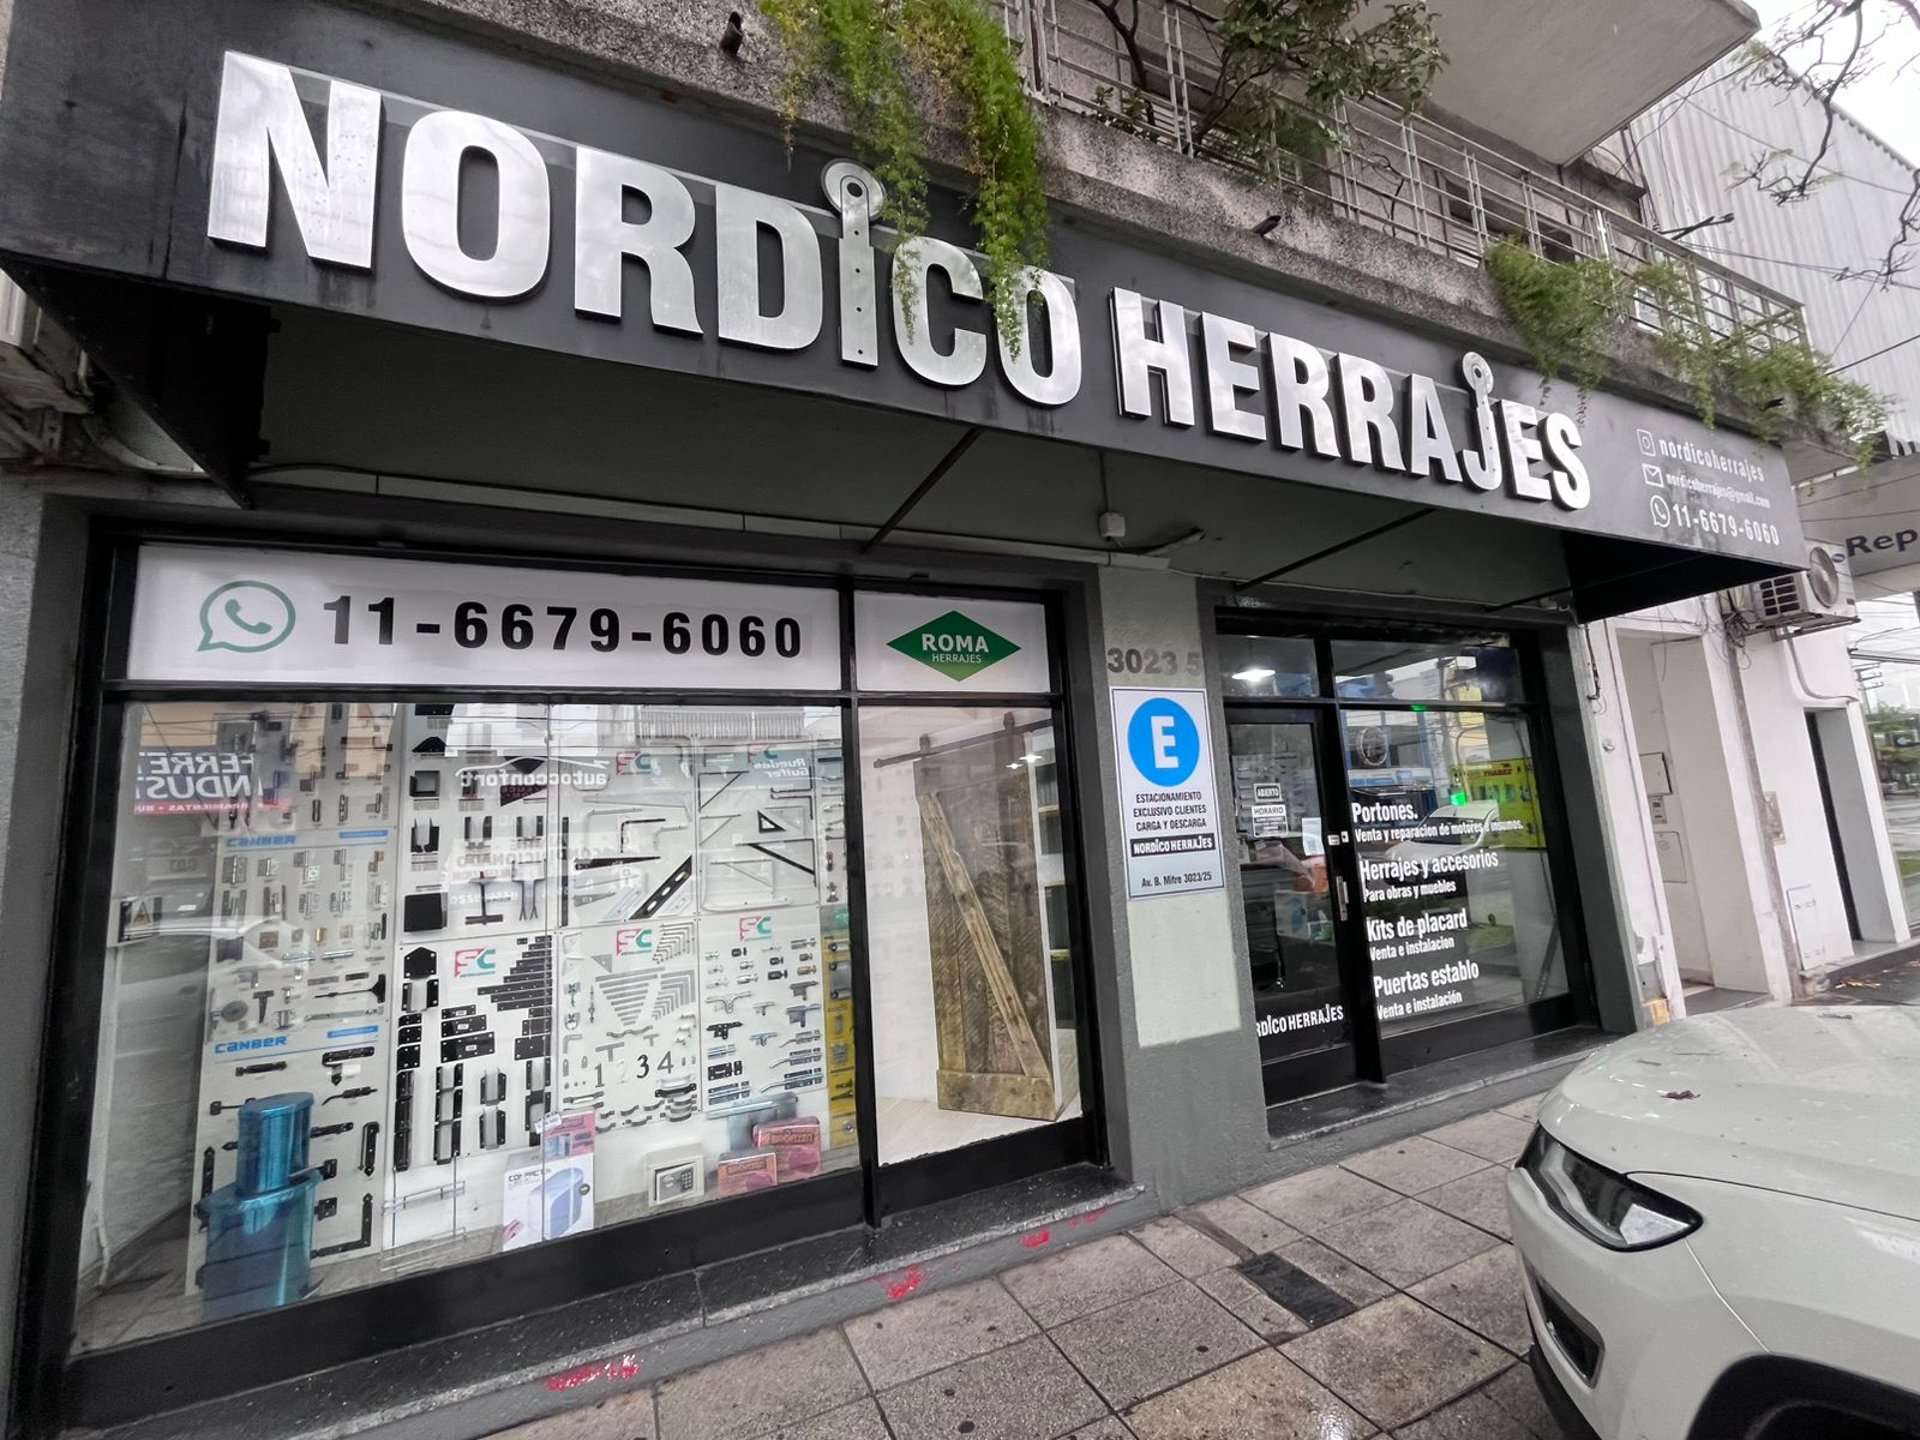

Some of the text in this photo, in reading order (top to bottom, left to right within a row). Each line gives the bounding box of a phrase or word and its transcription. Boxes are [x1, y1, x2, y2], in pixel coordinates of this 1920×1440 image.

[207, 51, 1591, 511] NORDICO HERRAJES
[1659, 439, 1765, 482] nordicoherrajes
[1672, 503, 1780, 545] 11-6679-6060
[323, 595, 802, 659] 11-6679-6060
[921, 633, 989, 653] ROMA
[931, 653, 982, 664] HERRAJES
[1107, 647, 1178, 676] 3023
[1150, 715, 1180, 769] E
[1136, 791, 1202, 804] ESTACIONAMIENTO
[1257, 787, 1279, 797] ABIERTO
[1133, 804, 1207, 818] EXCLUSIVO CLIENTES
[1254, 806, 1284, 815] HORARIO
[1351, 802, 1418, 823] Portones.
[1136, 818, 1207, 831] CARGA Y DESCARGA
[1355, 828, 1382, 843] Venta
[1384, 831, 1390, 844] y
[1439, 824, 1450, 835] de
[1450, 822, 1483, 834] motores
[1133, 835, 1213, 855] NORDICO HERRAJES
[1359, 849, 1499, 882] Herrajes y accesorios
[1141, 877, 1153, 888] Av.
[1154, 876, 1162, 887] B.
[1163, 875, 1182, 886] Mitre
[1363, 879, 1457, 903] Para obras y muebles
[1366, 907, 1468, 942] Kits de placard
[1369, 945, 1397, 961] Venta
[1398, 946, 1405, 957] e
[1373, 959, 1479, 998] Puertas establo
[1287, 1003, 1344, 1031] HERRAJES
[1377, 1003, 1404, 1020] Venta
[1405, 1002, 1412, 1014] e
